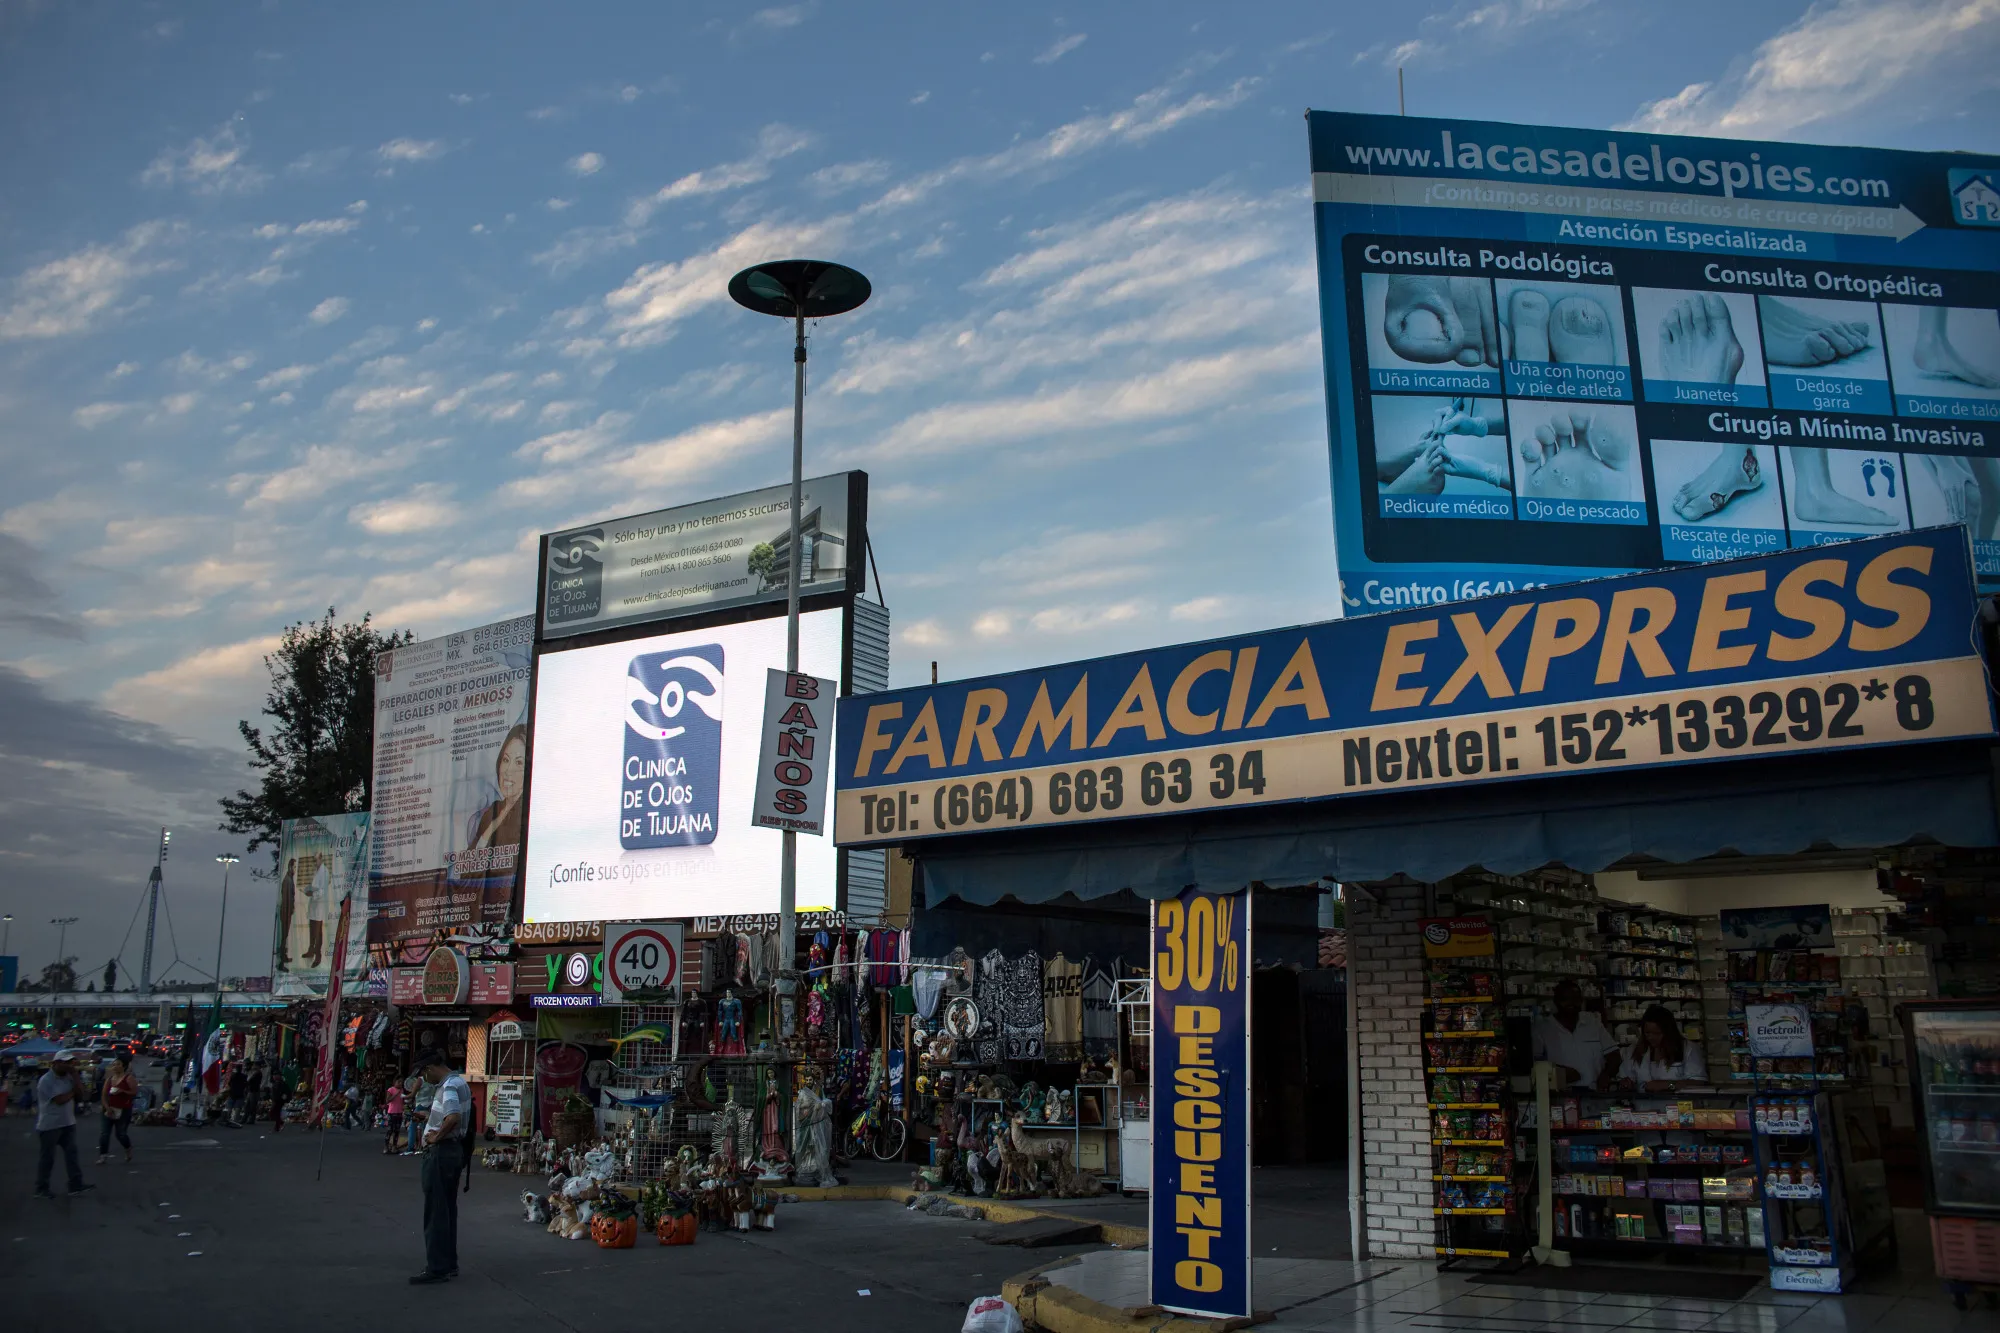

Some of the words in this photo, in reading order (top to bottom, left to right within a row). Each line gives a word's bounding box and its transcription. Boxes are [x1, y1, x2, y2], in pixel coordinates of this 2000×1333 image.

[1345, 130, 1890, 199] www.lacasadelospies.com
[1544, 190, 1581, 209] con
[1586, 194, 1645, 214] pases
[1649, 198, 1732, 221] médicos
[1737, 202, 1761, 223] de
[1765, 209, 1819, 225] cruce
[1558, 219, 1659, 243] Atención
[1664, 226, 1808, 253] Especializada
[1364, 244, 1472, 268] Consulta
[1479, 249, 1615, 279] Podológica
[1704, 263, 1808, 289] Consulta
[1813, 271, 1943, 299] Ortopédica
[1378, 371, 1412, 388] Uña
[1414, 373, 1491, 390] incarnada
[1509, 361, 1541, 377] Uña
[1544, 367, 1572, 380] con
[1576, 366, 1626, 383] hongo
[1516, 383, 1525, 396] y
[1529, 380, 1554, 396] pie
[1557, 381, 1577, 396] de
[1579, 383, 1622, 398] atleta
[1672, 386, 1739, 402] Juanetes
[1795, 379, 1842, 395] Dedos
[1844, 382, 1863, 396] de
[1813, 397, 1850, 410] garra
[1908, 399, 1947, 416] Dolor
[1950, 401, 1969, 417] de
[1971, 402, 2000, 418] taló
[1708, 411, 1793, 440] Cirugía
[1799, 417, 1887, 442] Mínima
[1892, 422, 1985, 447] Invasiva
[1384, 498, 1450, 514] Pedicure
[1453, 499, 1509, 516] médico
[1525, 501, 1553, 519] Ojo
[1556, 502, 1576, 517] de
[1579, 504, 1640, 521] pescado
[614, 530, 637, 544] Sólo
[637, 527, 656, 543] hay
[657, 522, 676, 536] una
[677, 522, 685, 534] y
[686, 517, 700, 530] no
[702, 509, 747, 528] tenemos
[1670, 526, 1729, 544] Rescate
[1731, 529, 1752, 544] de
[1754, 530, 1777, 547] pie
[630, 555, 652, 568] Desde
[654, 551, 680, 564] México
[640, 567, 659, 579] From
[660, 564, 676, 576] USA
[682, 559, 697, 571] 800
[1363, 579, 1448, 604] Centro
[853, 636, 1331, 779] FARMACIA
[1368, 545, 1936, 714] EXPRESS
[380, 687, 443, 711] PREPARACION
[445, 683, 458, 695] DE
[393, 703, 435, 724] LEGALES
[437, 699, 459, 714] POR
[773, 674, 820, 816] BAÑOS
[861, 790, 919, 835] Tel:
[933, 776, 1034, 831] (664)
[1049, 766, 1125, 816] 683
[1140, 757, 1193, 807] 63
[1209, 750, 1267, 800] 34
[1342, 723, 1519, 788] Nextel:
[623, 789, 643, 810] DE
[648, 782, 693, 807] OJOS
[621, 818, 642, 838] DE
[647, 811, 713, 836] TIJUANA
[597, 863, 619, 881] sus
[622, 861, 650, 885] ojos
[1450, 920, 1487, 930] Sabritas
[620, 943, 659, 970] 40
[1157, 896, 1238, 993] 30%
[624, 974, 659, 986] km/h
[533, 996, 562, 1006] FROZEN
[562, 996, 593, 1006] YOGURT
[1757, 1025, 1805, 1035] Electrolit
[1173, 1005, 1223, 1293] DESCUENTO
